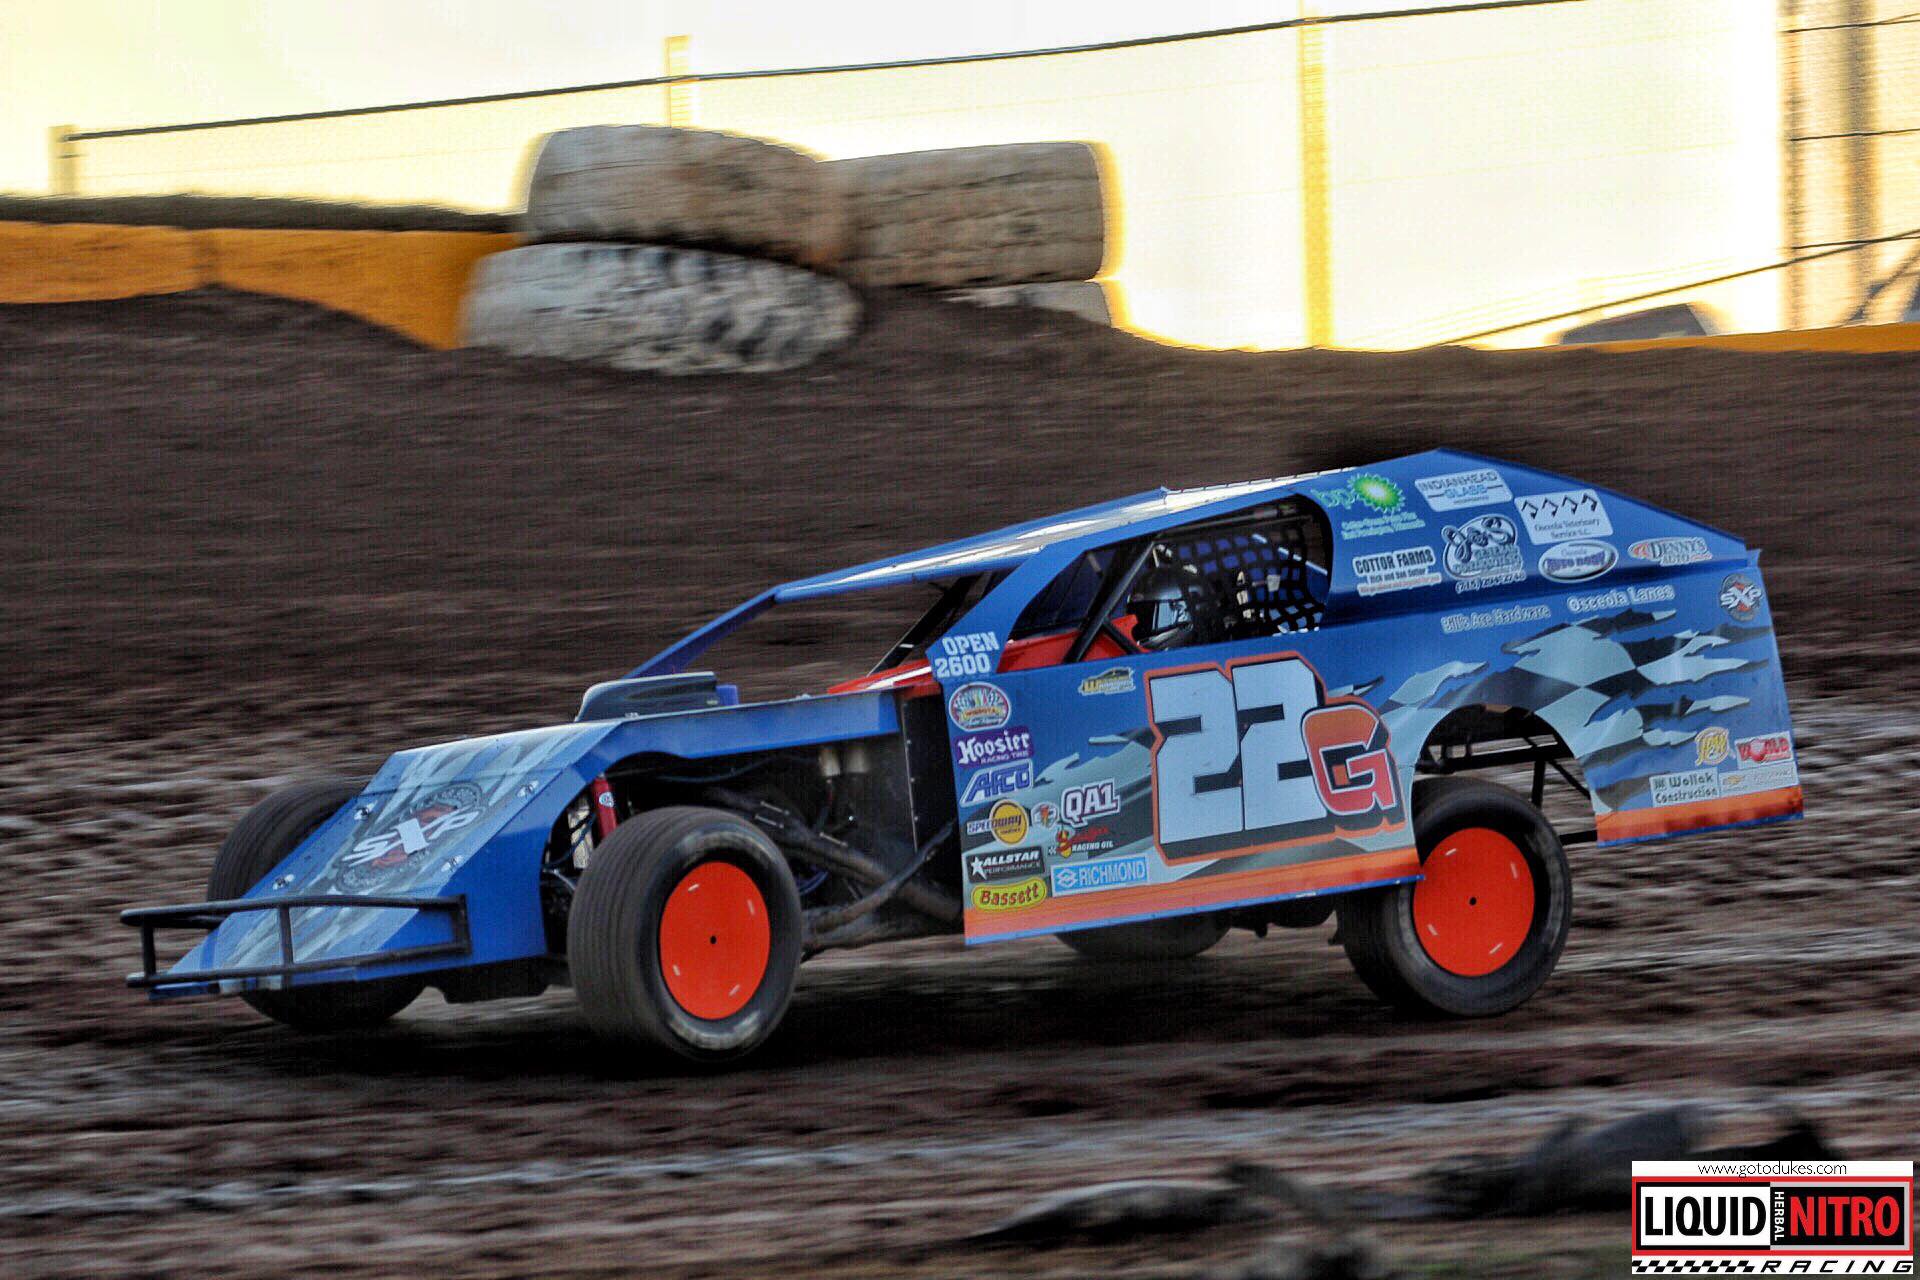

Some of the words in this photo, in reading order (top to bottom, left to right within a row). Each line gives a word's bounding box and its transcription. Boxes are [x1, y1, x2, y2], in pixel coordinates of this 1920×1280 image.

[1355, 555, 1396, 575] COTTOR
[1396, 548, 1434, 568] FARMS
[1629, 584, 1676, 606] Lanes
[942, 632, 1000, 656] OPEN
[934, 653, 990, 678] 2600
[957, 730, 1030, 765] Hoosier
[962, 764, 1032, 803] AFCO
[1065, 781, 1118, 824] QA1
[982, 850, 1040, 867] ALLSTAR
[1079, 862, 1146, 886] RICHMOND
[979, 882, 1040, 906] Bassett
